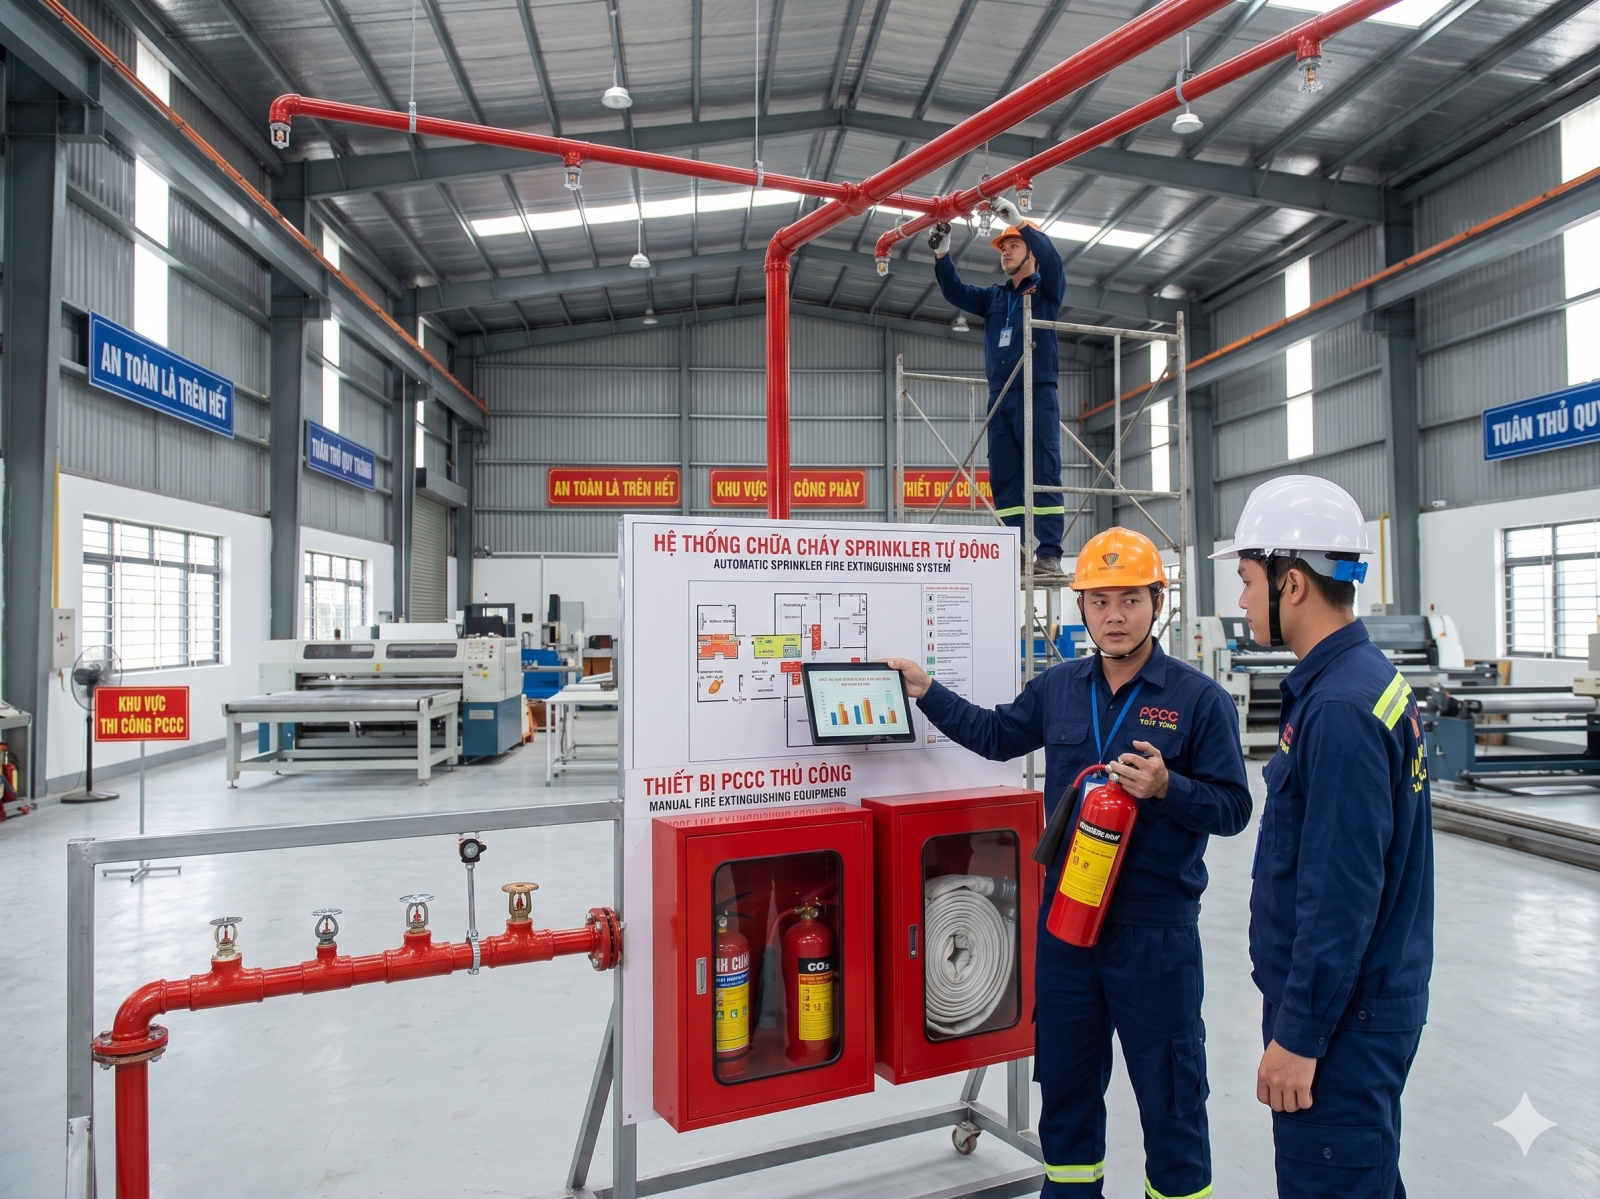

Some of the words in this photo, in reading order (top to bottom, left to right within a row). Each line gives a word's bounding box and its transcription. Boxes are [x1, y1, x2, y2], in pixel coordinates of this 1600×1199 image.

[101, 342, 121, 377] AN
[125, 352, 158, 392] TOÀN
[162, 367, 176, 400] LÀ
[179, 378, 206, 412] TRÊN
[209, 384, 227, 420] HẾT
[1492, 415, 1533, 446] TUÂN
[1537, 400, 1568, 437] THỦ
[554, 481, 570, 496] AN
[573, 478, 602, 496] TOÀN
[606, 478, 620, 496] LÀ
[623, 477, 651, 496] TRÊN
[655, 474, 675, 496] HẾT
[717, 481, 740, 497] KHU
[743, 480, 767, 501] VỰC
[794, 478, 826, 497] CÔNG
[829, 479, 860, 497] PHÀY
[654, 530, 676, 556] HỆ
[682, 529, 740, 554] THỐNG
[746, 534, 791, 555] CHỮA
[797, 534, 840, 556] CHÁY
[845, 539, 930, 557] SPRINKLER
[935, 540, 955, 562] TỰ
[959, 539, 999, 563] ĐỘNG
[714, 559, 768, 570] AUTOMATIC
[771, 560, 822, 571] SPRINKLER
[825, 561, 844, 571] FIRE
[848, 561, 914, 572] EXTINGUISHING
[916, 563, 950, 573] SYSTEM
[119, 696, 141, 712] KHU
[144, 694, 166, 715] VỰC
[100, 718, 118, 734] THI
[121, 714, 152, 734] CÔNG
[155, 717, 184, 733] PCCC
[643, 769, 694, 796] THIẾT
[700, 774, 715, 795] BỊ
[722, 770, 765, 790] PCCC
[770, 762, 803, 787] THỦ
[808, 762, 851, 784] CÔNG
[650, 799, 691, 812] MANUAL
[695, 797, 716, 808] FIRE
[719, 791, 790, 806] EXTINGUISHING
[794, 787, 847, 800] EQUIPMENG
